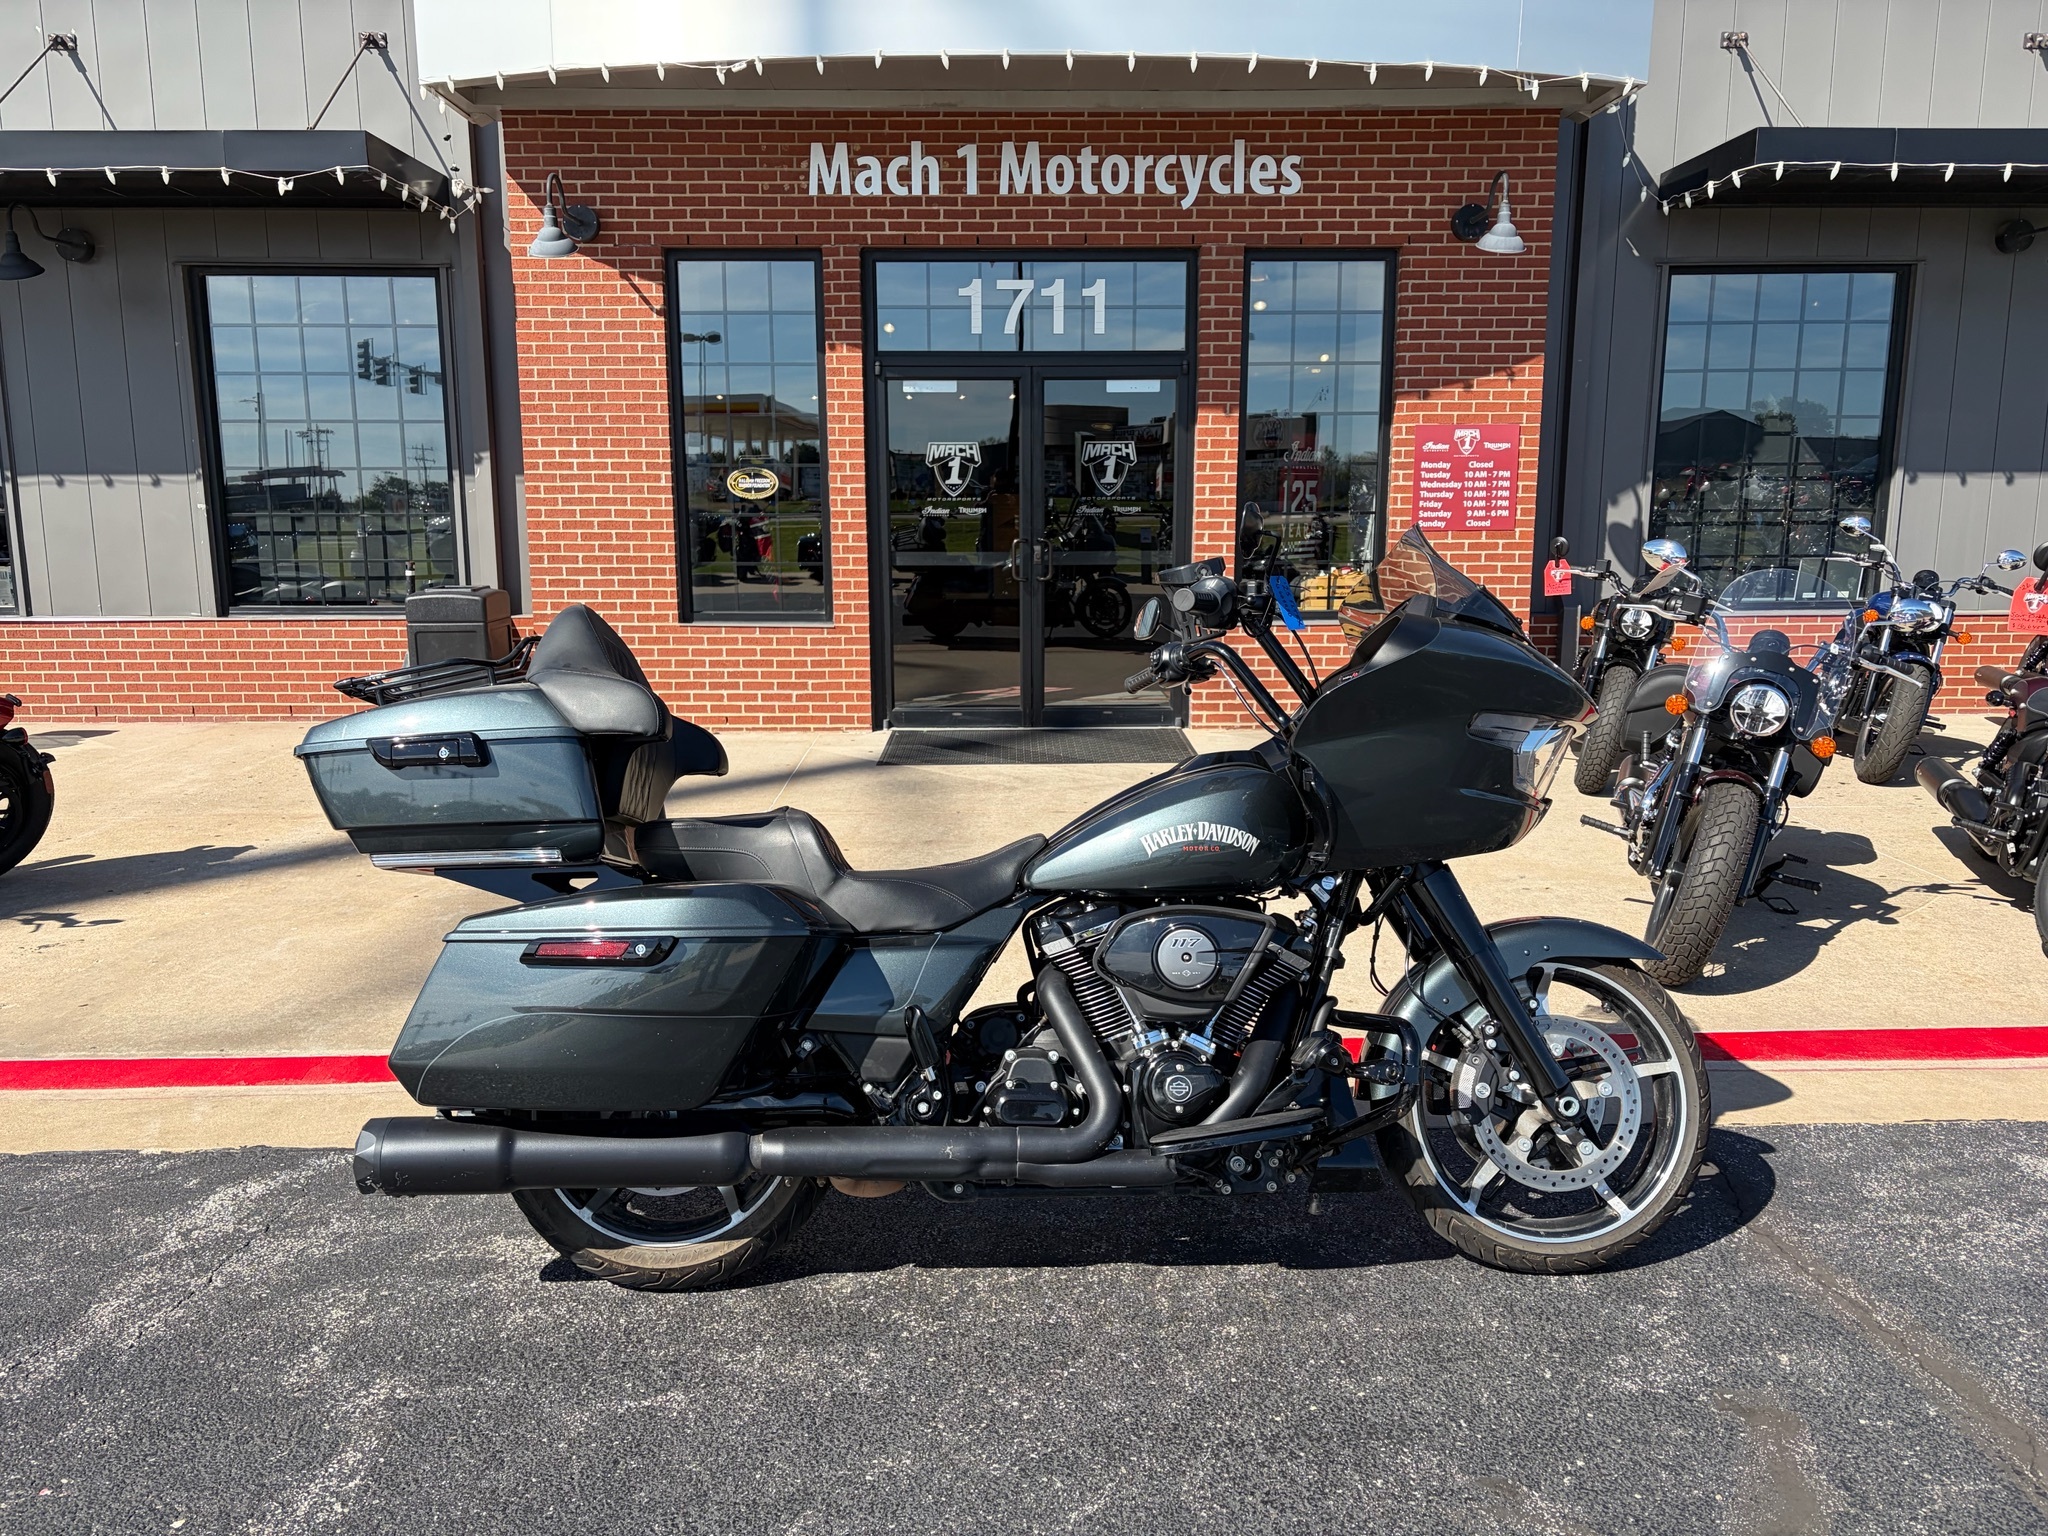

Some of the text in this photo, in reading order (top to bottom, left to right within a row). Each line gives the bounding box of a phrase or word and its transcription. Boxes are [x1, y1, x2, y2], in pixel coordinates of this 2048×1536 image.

[809, 139, 1302, 210] Mach 1 Motorcycles
[958, 278, 1106, 334] 1711
[1422, 441, 1450, 449] Indian
[1462, 436, 1472, 449] 1
[1483, 441, 1511, 449] TRIUMPH
[929, 444, 979, 462] MACH
[1084, 443, 1134, 461] MACH
[1100, 455, 1118, 484] 1
[1421, 461, 1451, 470] Monday
[945, 456, 963, 485] 1
[1420, 471, 1451, 480] Tuesday
[1420, 481, 1462, 490] Wednesday
[1282, 480, 1318, 518] 125
[1420, 490, 1454, 499] Thursday
[1112, 505, 1141, 513] TRIUMPH
[1419, 500, 1442, 509] Friday
[921, 505, 987, 514] Indian TRIUMPH
[1418, 510, 1452, 519] Saturday
[1418, 519, 1490, 528] Sunday Closed
[1170, 936, 1203, 949] 117
